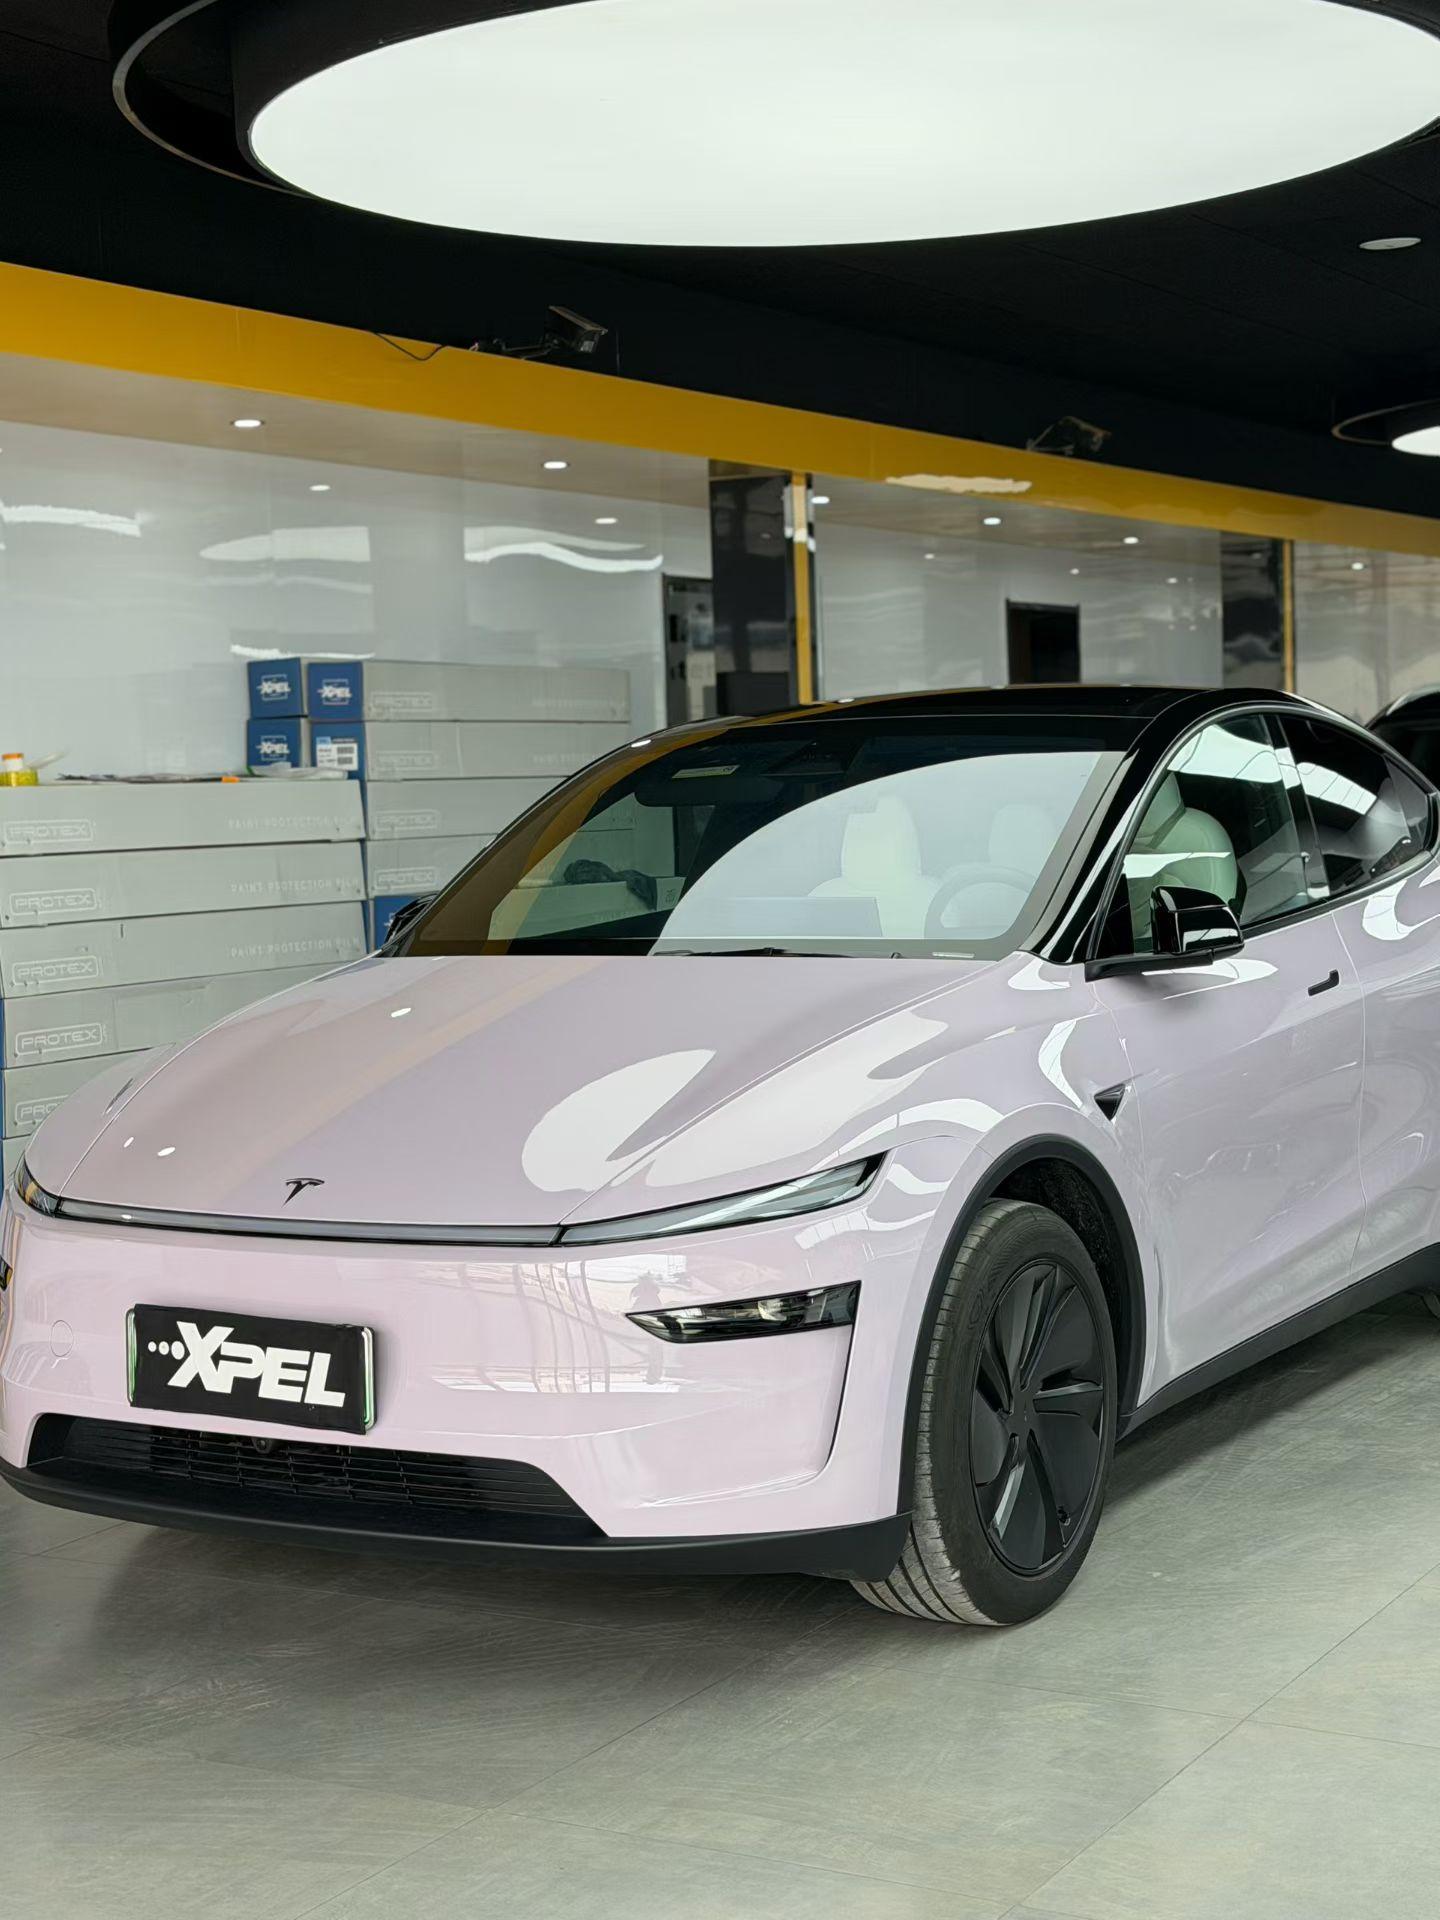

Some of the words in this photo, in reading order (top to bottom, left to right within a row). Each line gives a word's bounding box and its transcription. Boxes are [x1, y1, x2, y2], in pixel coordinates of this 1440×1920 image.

[260, 681, 291, 695] XPEL
[322, 686, 352, 699] XPEL
[260, 741, 290, 754] XPEL
[8, 823, 89, 838] PROTEX
[15, 894, 91, 909] PROTEX
[268, 938, 331, 953] PROTECTION
[18, 961, 94, 979] PROTEX
[21, 1028, 97, 1049] PROTEX
[167, 1320, 346, 1408] XPEL
